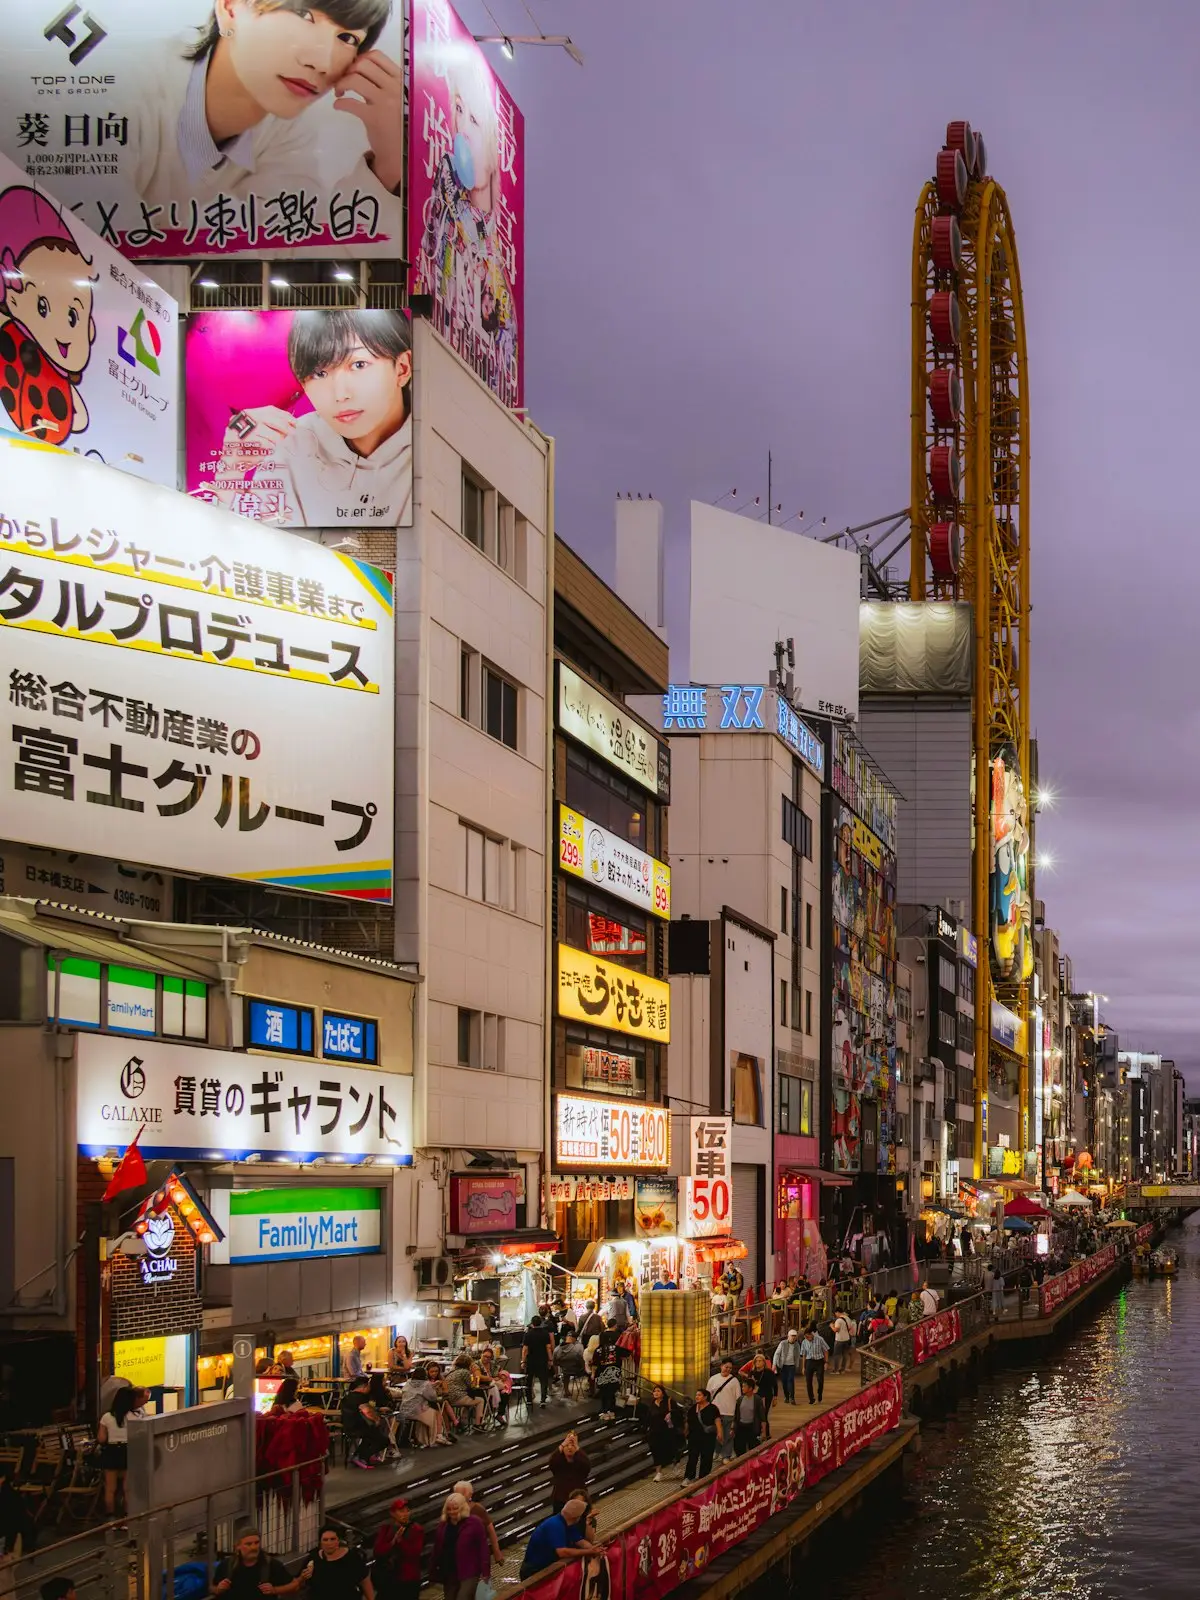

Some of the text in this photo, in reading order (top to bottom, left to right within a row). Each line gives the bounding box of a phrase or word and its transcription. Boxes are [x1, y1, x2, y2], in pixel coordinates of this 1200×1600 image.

[109, 263, 172, 324] 総合不動産業の
[107, 358, 171, 413] 富士グループ
[9, 668, 261, 761] 総合不動産業の
[13, 723, 378, 852] 富士グループ
[561, 840, 579, 867] 299
[655, 885, 667, 911] 99
[265, 1009, 284, 1044] 酒
[324, 1020, 362, 1055] たばこ
[101, 1104, 163, 1124] GALAXIE
[173, 1070, 398, 1140] 賃貸のギャラント
[610, 1109, 631, 1160] 50
[692, 1121, 730, 1220] 伝串 50
[259, 1215, 358, 1250] FamilyMart
[123, 1353, 163, 1367] RESTAURANT
[181, 1424, 228, 1444] information
